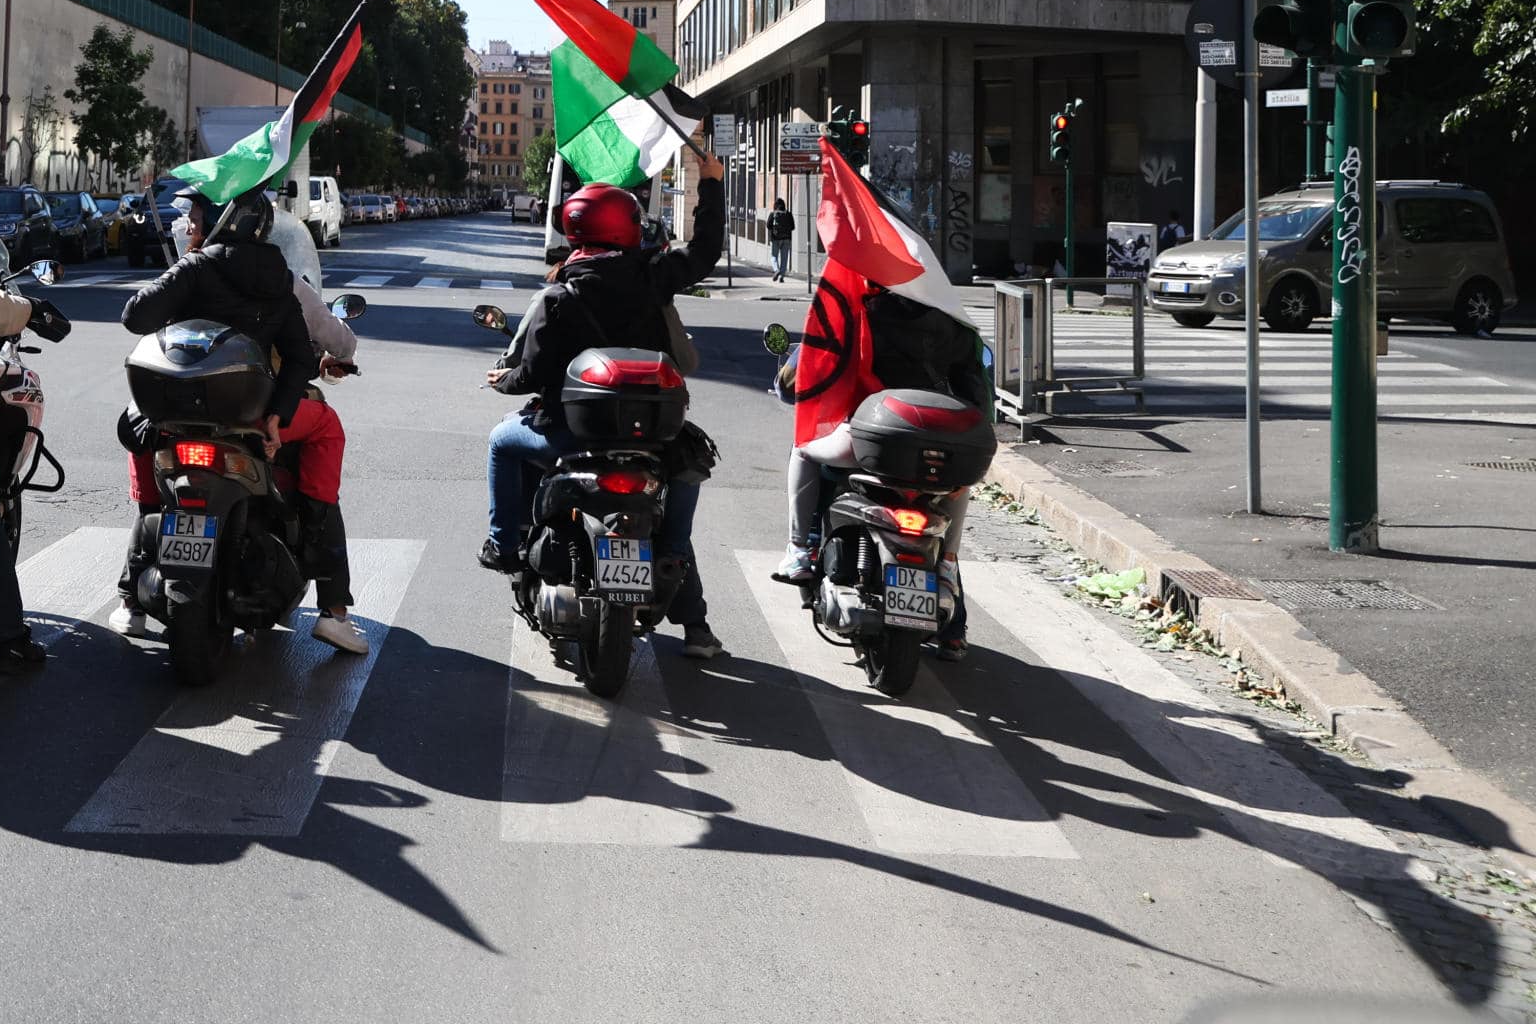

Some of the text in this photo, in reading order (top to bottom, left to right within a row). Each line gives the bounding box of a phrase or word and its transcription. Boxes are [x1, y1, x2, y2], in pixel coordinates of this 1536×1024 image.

[175, 515, 195, 535] EA
[162, 540, 213, 562] 45987
[610, 540, 631, 559] EM
[601, 564, 651, 586] 44542
[898, 568, 918, 588] DX
[887, 590, 935, 616] 86420
